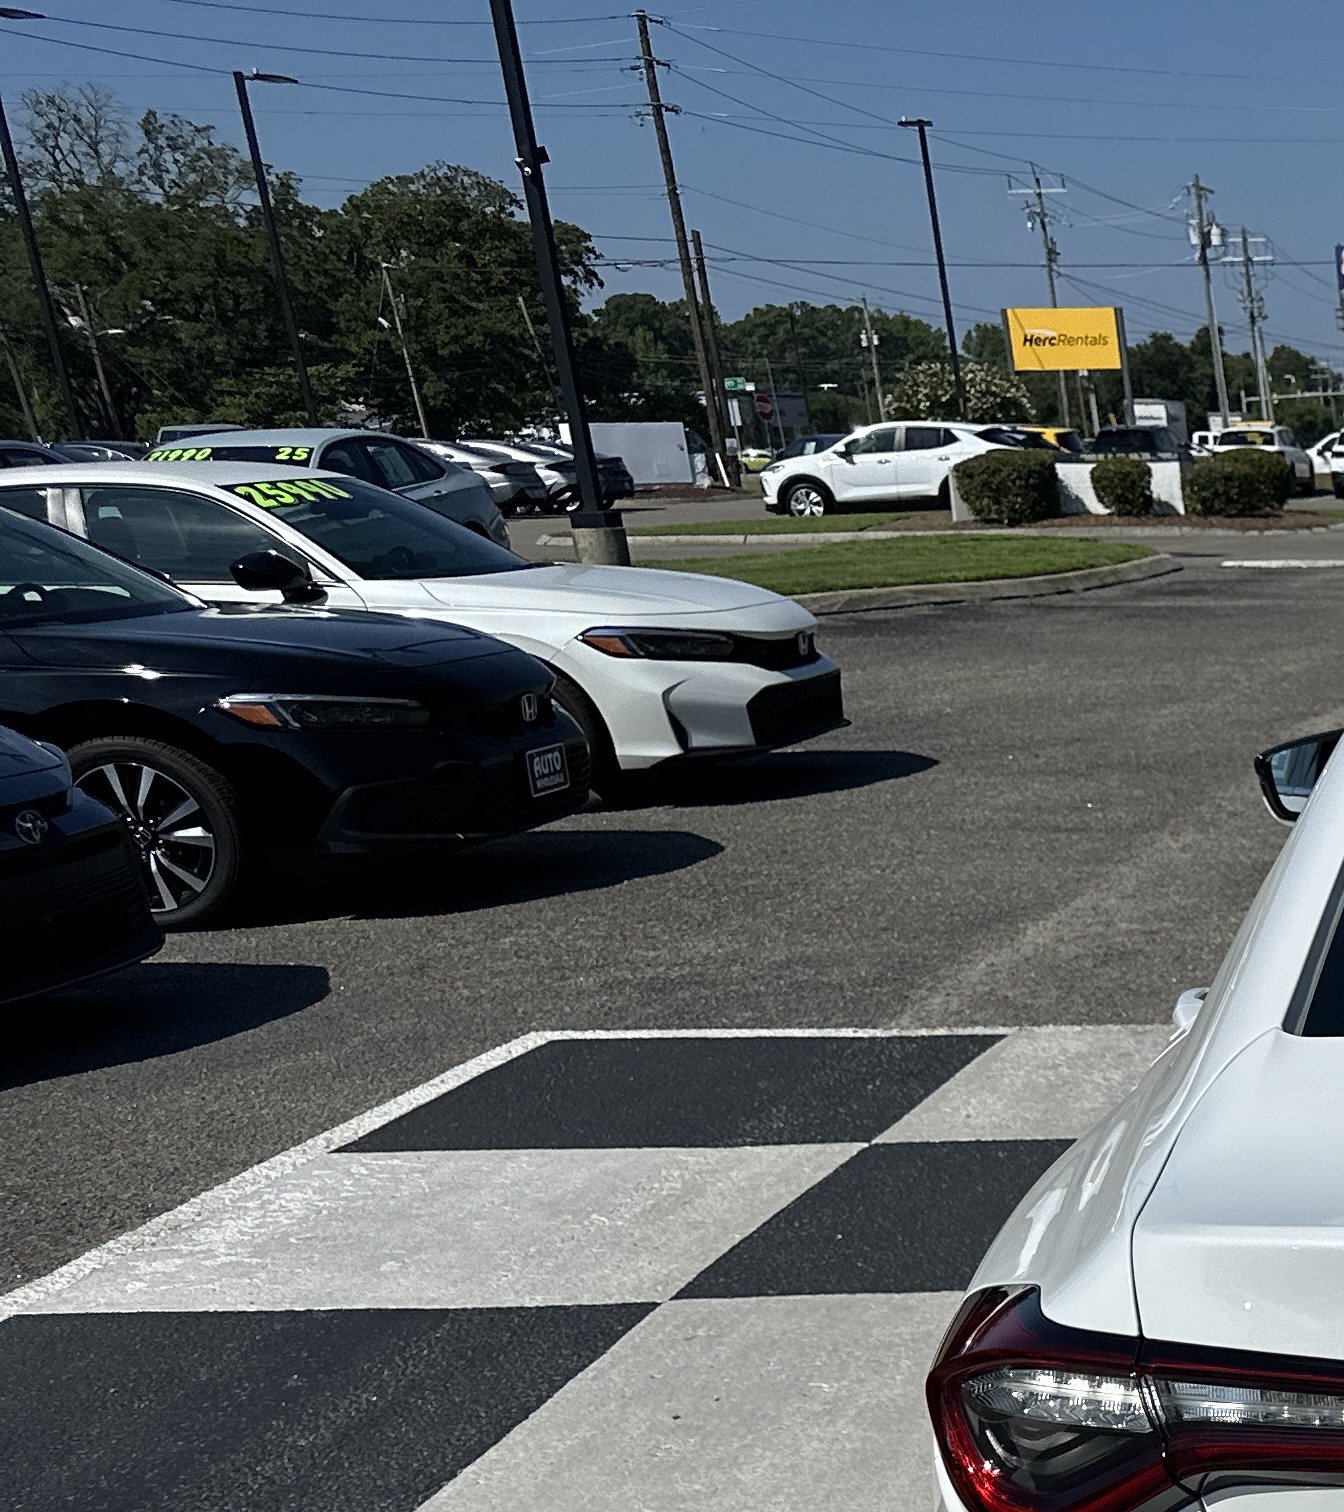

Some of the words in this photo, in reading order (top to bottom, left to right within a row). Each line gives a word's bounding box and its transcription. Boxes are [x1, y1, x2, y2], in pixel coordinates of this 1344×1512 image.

[275, 448, 310, 461] 25
[234, 479, 354, 508] 25990
[533, 751, 562, 779] AUTO
